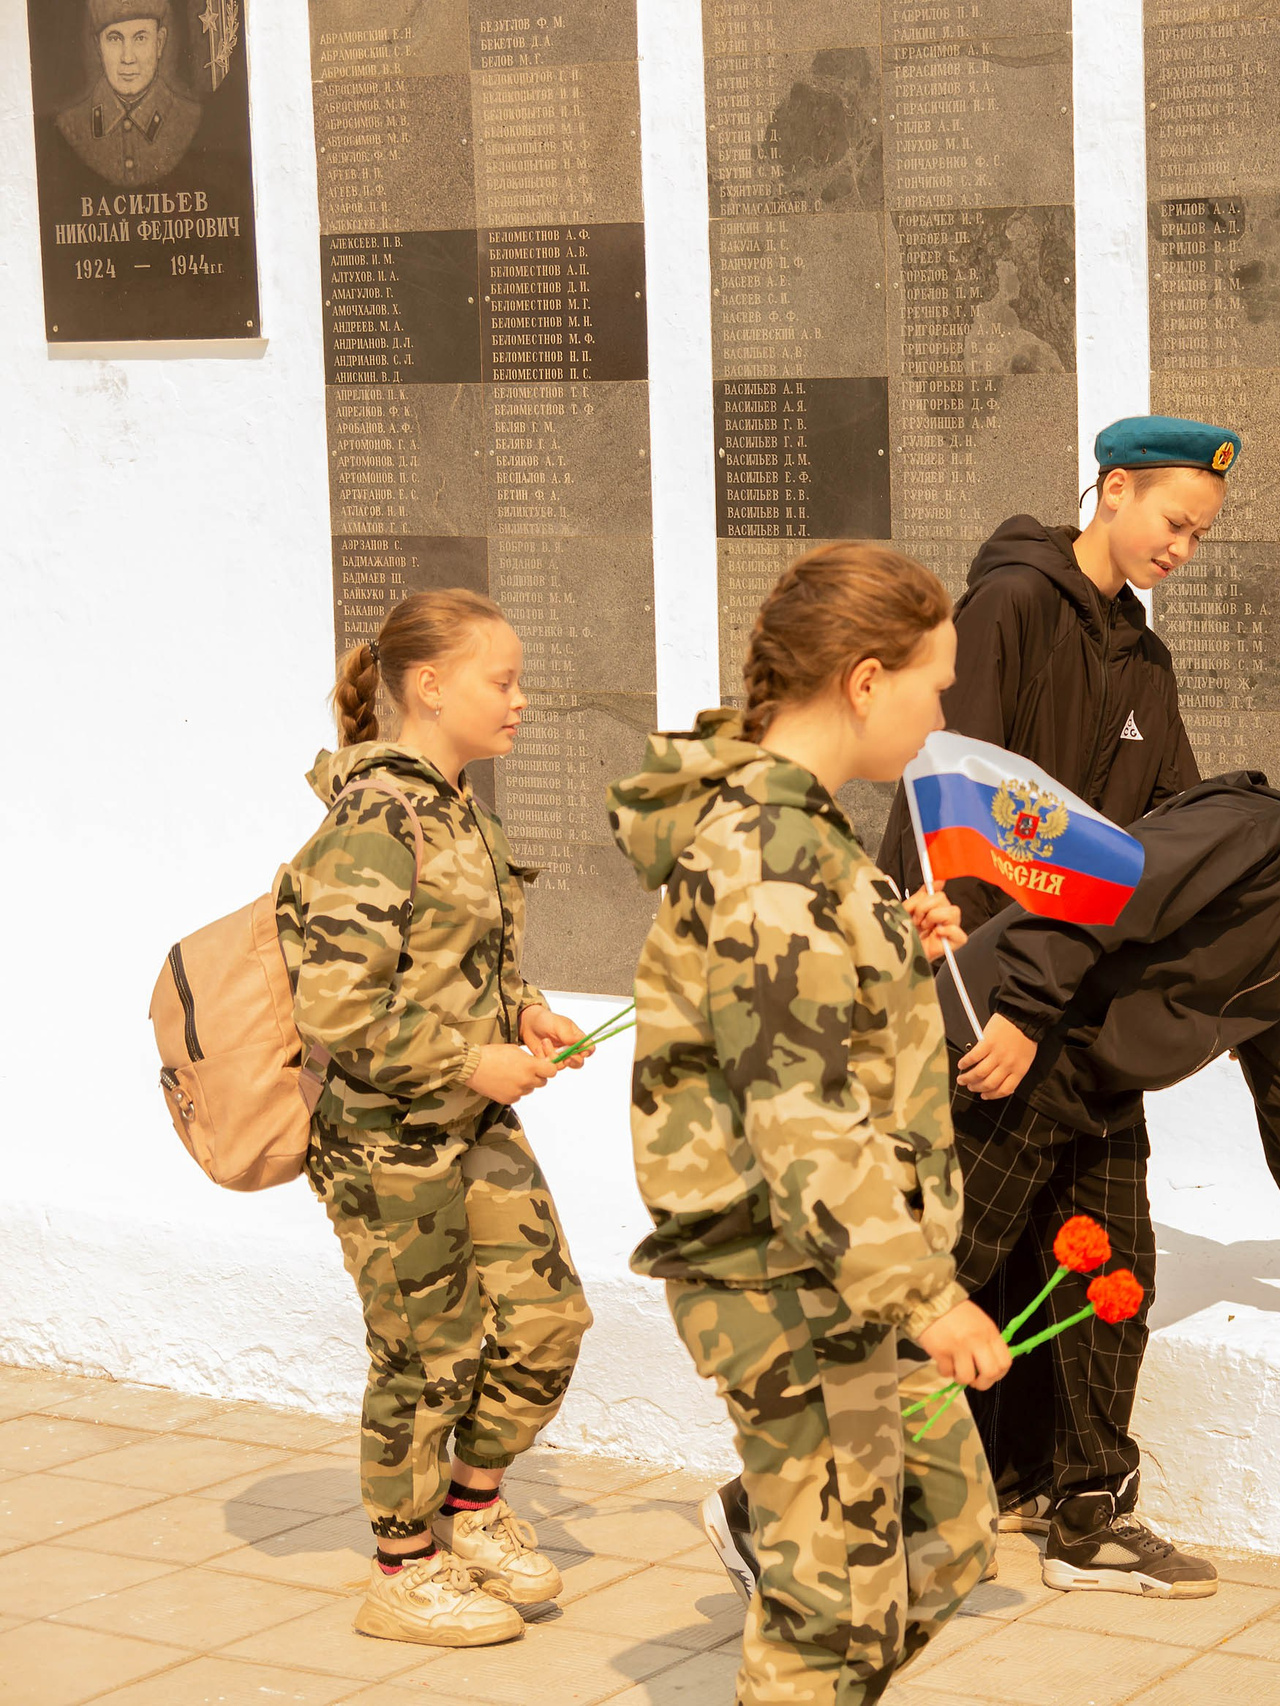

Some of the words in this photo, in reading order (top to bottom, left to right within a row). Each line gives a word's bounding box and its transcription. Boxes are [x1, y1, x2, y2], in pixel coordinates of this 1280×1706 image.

[81, 191, 208, 217] ВАСИЛЬЕВ
[1161, 203, 1205, 217] ЕРИЛОВ
[56, 219, 130, 244] НИКОЛАЙ
[137, 217, 240, 244] ФЕДОРОВИЧ
[1161, 222, 1205, 236] ЕРИЛОВ
[489, 230, 559, 243] БЕЛОМЕСТНОВ
[75, 258, 116, 279] 1924
[492, 317, 562, 328] БЕЛОМЕСТНОВ
[493, 368, 563, 380] БЕЛОМЕСТНОВ
[725, 401, 777, 412] ВАСИЛЬЕВ
[725, 419, 777, 430] ВАСИЛЬЕВ
[727, 454, 778, 466] ВАСИЛЬЕВ
[727, 472, 778, 483] ВАСИЛЬЕВ
